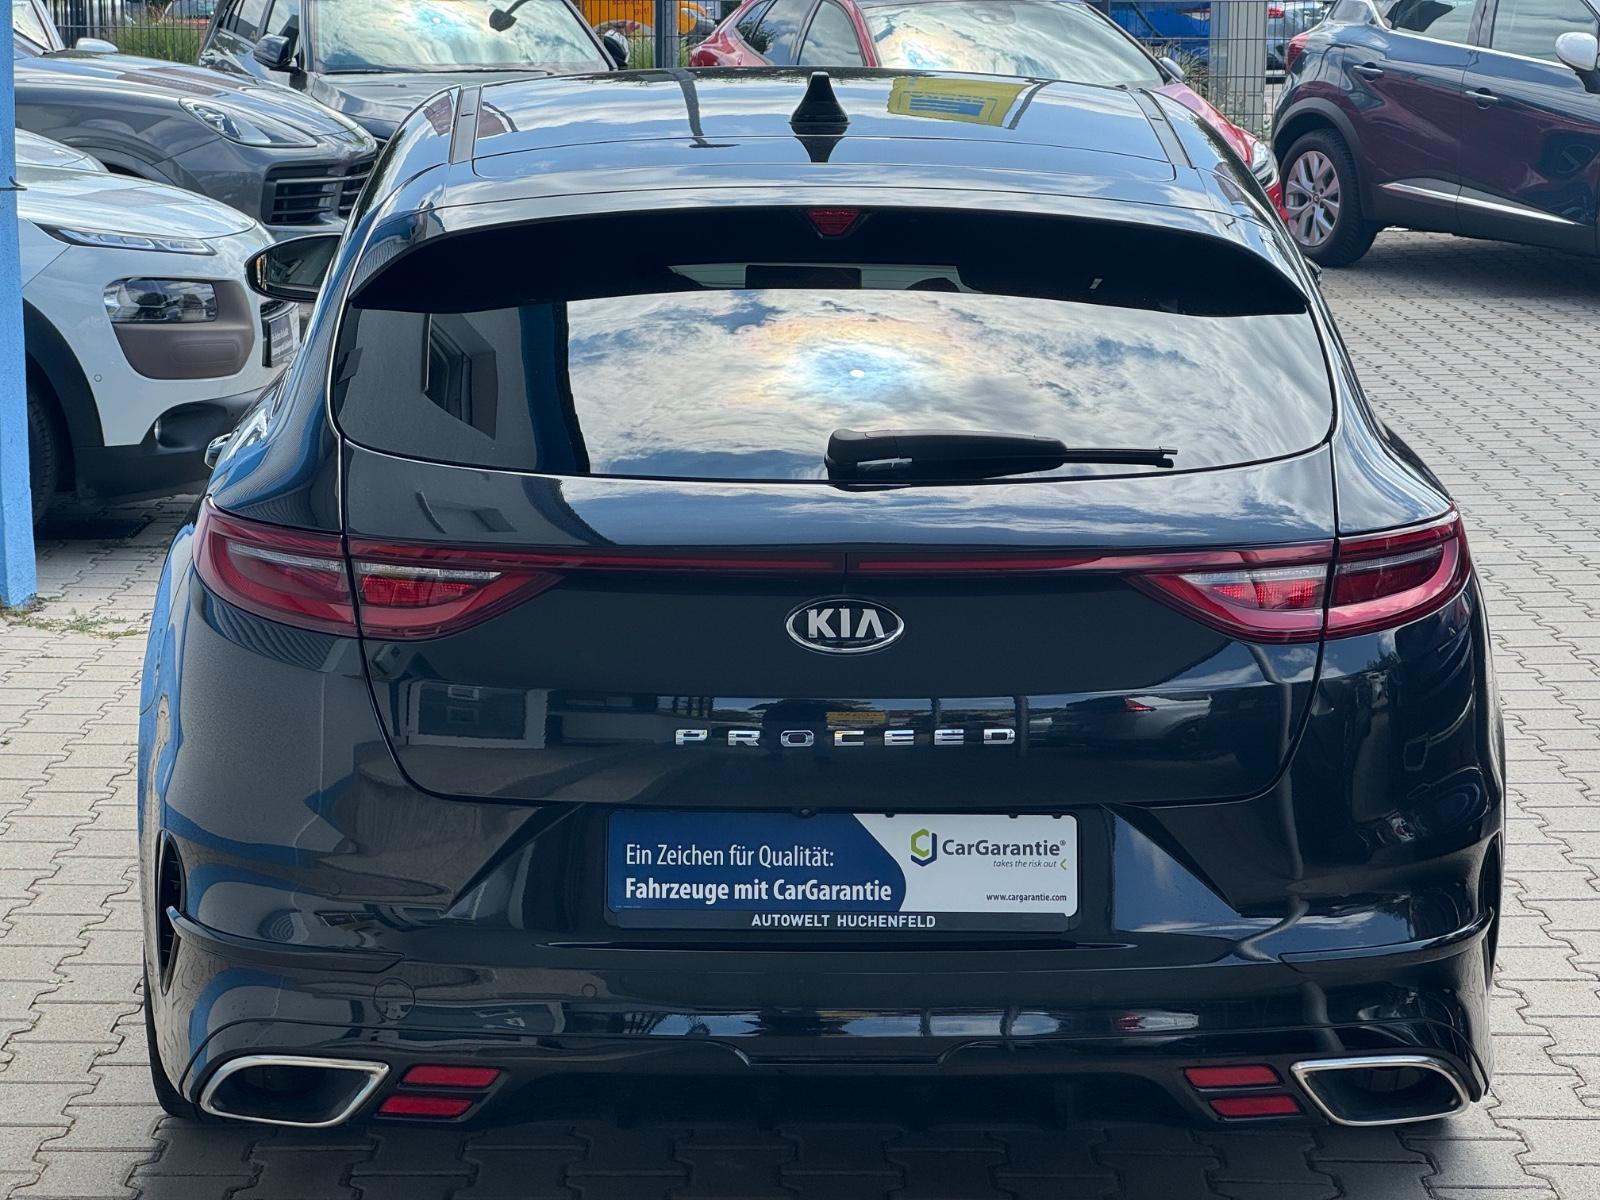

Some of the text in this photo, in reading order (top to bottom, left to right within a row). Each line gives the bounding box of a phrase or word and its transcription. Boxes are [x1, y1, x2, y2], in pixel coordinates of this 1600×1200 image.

[807, 608, 885, 638] KIA
[675, 729, 1015, 746] PROCEED
[626, 843, 834, 868] Ein Zeichen für Qualität:
[993, 858, 1057, 868] takes the risk out
[625, 877, 892, 905] Fahrzeuge mit CarGarantie
[986, 892, 1067, 903] www.cargarantie.com
[751, 914, 936, 928] AUTOWELT HUCHENFELD
